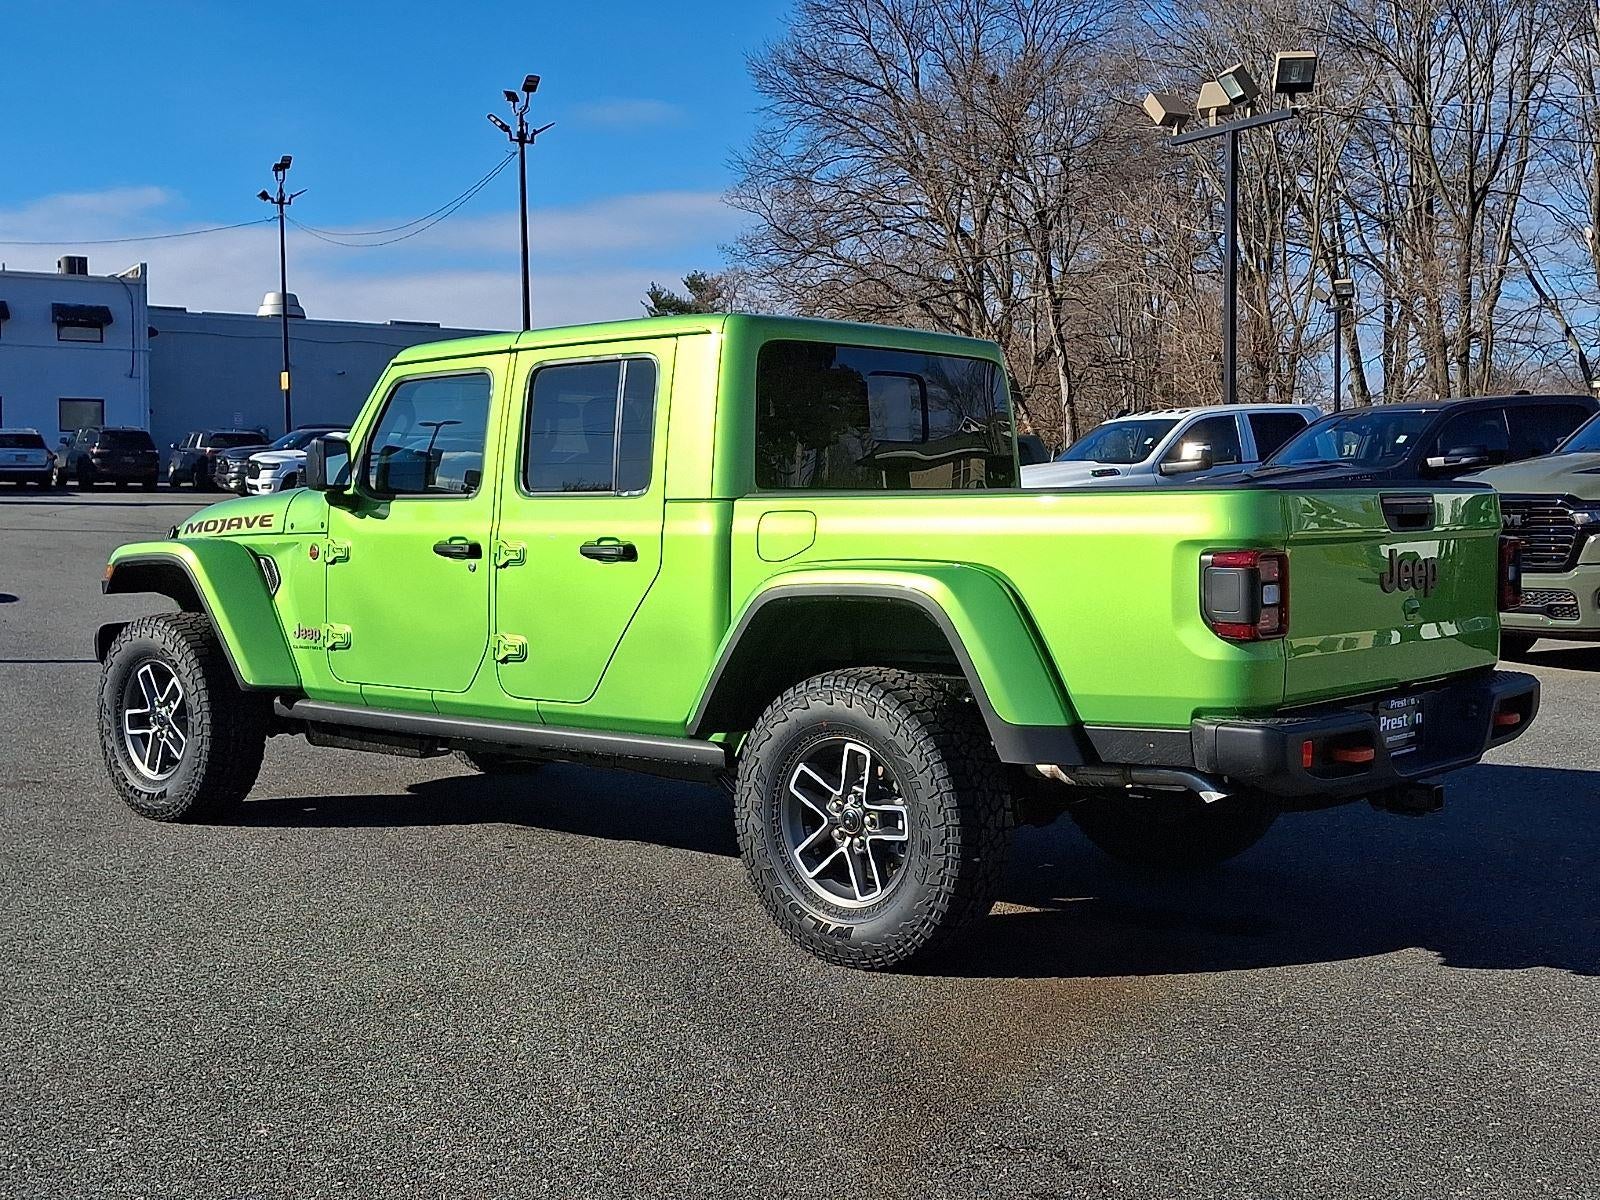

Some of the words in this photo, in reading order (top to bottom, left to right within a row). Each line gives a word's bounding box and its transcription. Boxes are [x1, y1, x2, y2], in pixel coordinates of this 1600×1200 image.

[184, 514, 274, 534] MOJAVE
[1379, 548, 1438, 597] Jeep
[293, 623, 321, 643] Jeep
